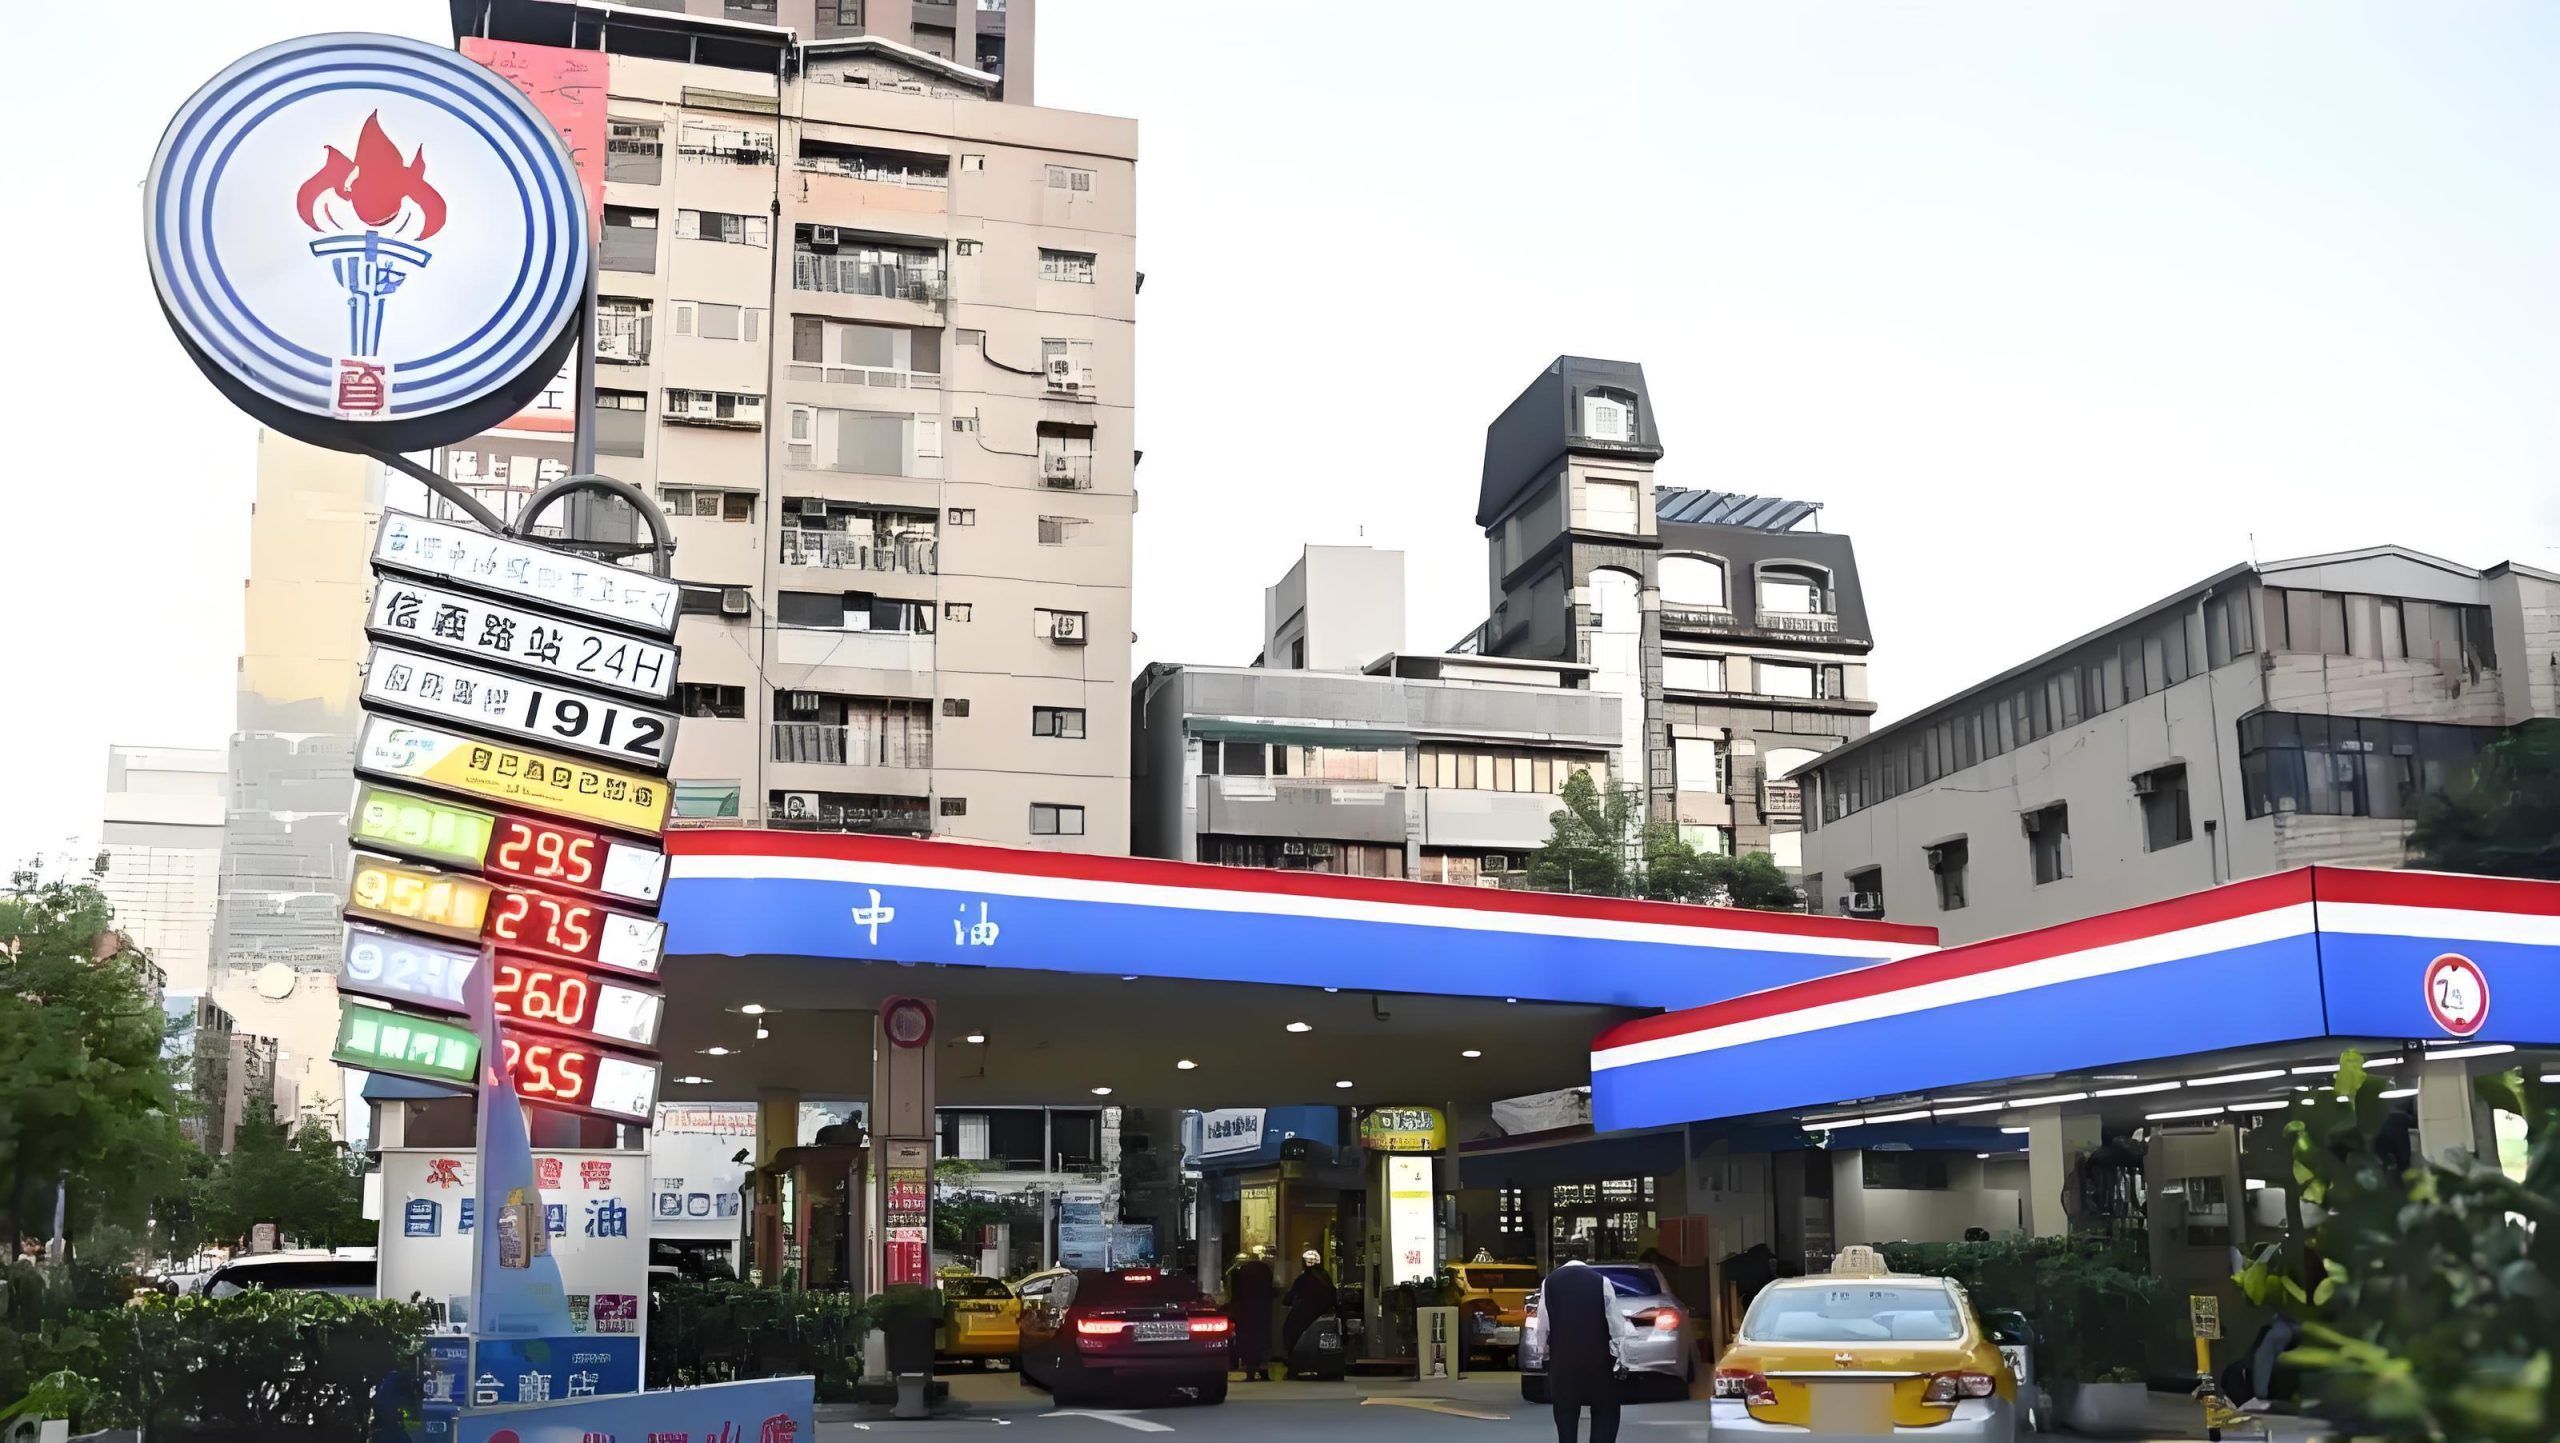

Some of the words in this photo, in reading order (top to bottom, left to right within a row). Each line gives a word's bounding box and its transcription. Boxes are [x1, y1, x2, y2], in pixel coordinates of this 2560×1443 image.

[576, 635, 664, 688] 24H
[524, 690, 665, 757] 1912
[851, 888, 1000, 946] 中油
